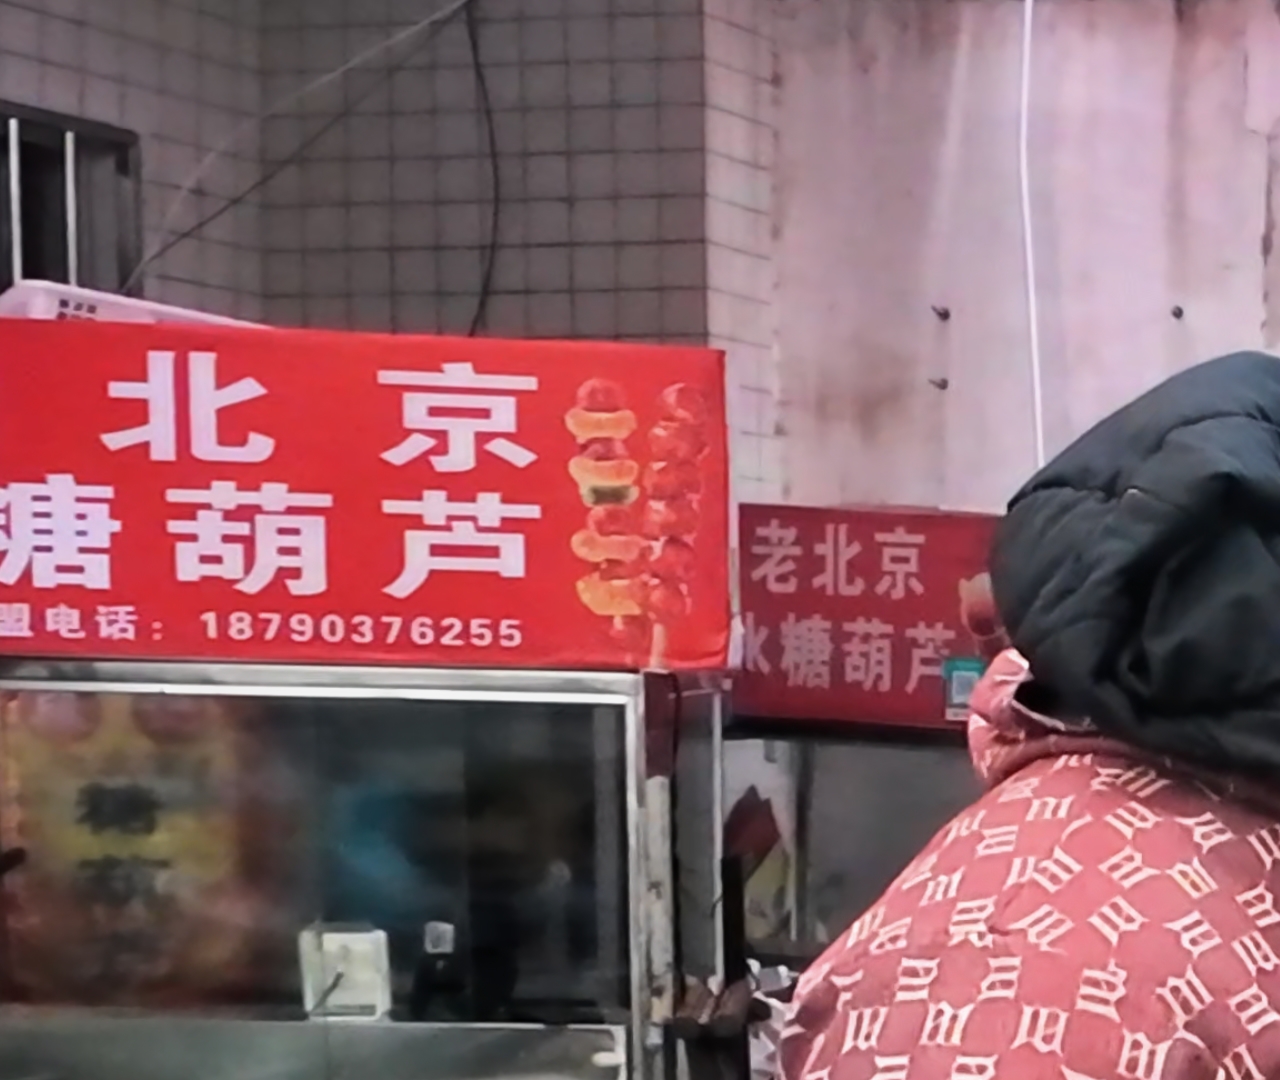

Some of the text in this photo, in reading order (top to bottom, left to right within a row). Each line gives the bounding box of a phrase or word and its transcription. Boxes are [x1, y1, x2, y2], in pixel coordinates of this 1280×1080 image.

[100, 350, 539, 472] 北京
[0, 473, 542, 599] 糖葫芦
[751, 518, 926, 600] 老北京
[200, 610, 523, 648] 18790376255
